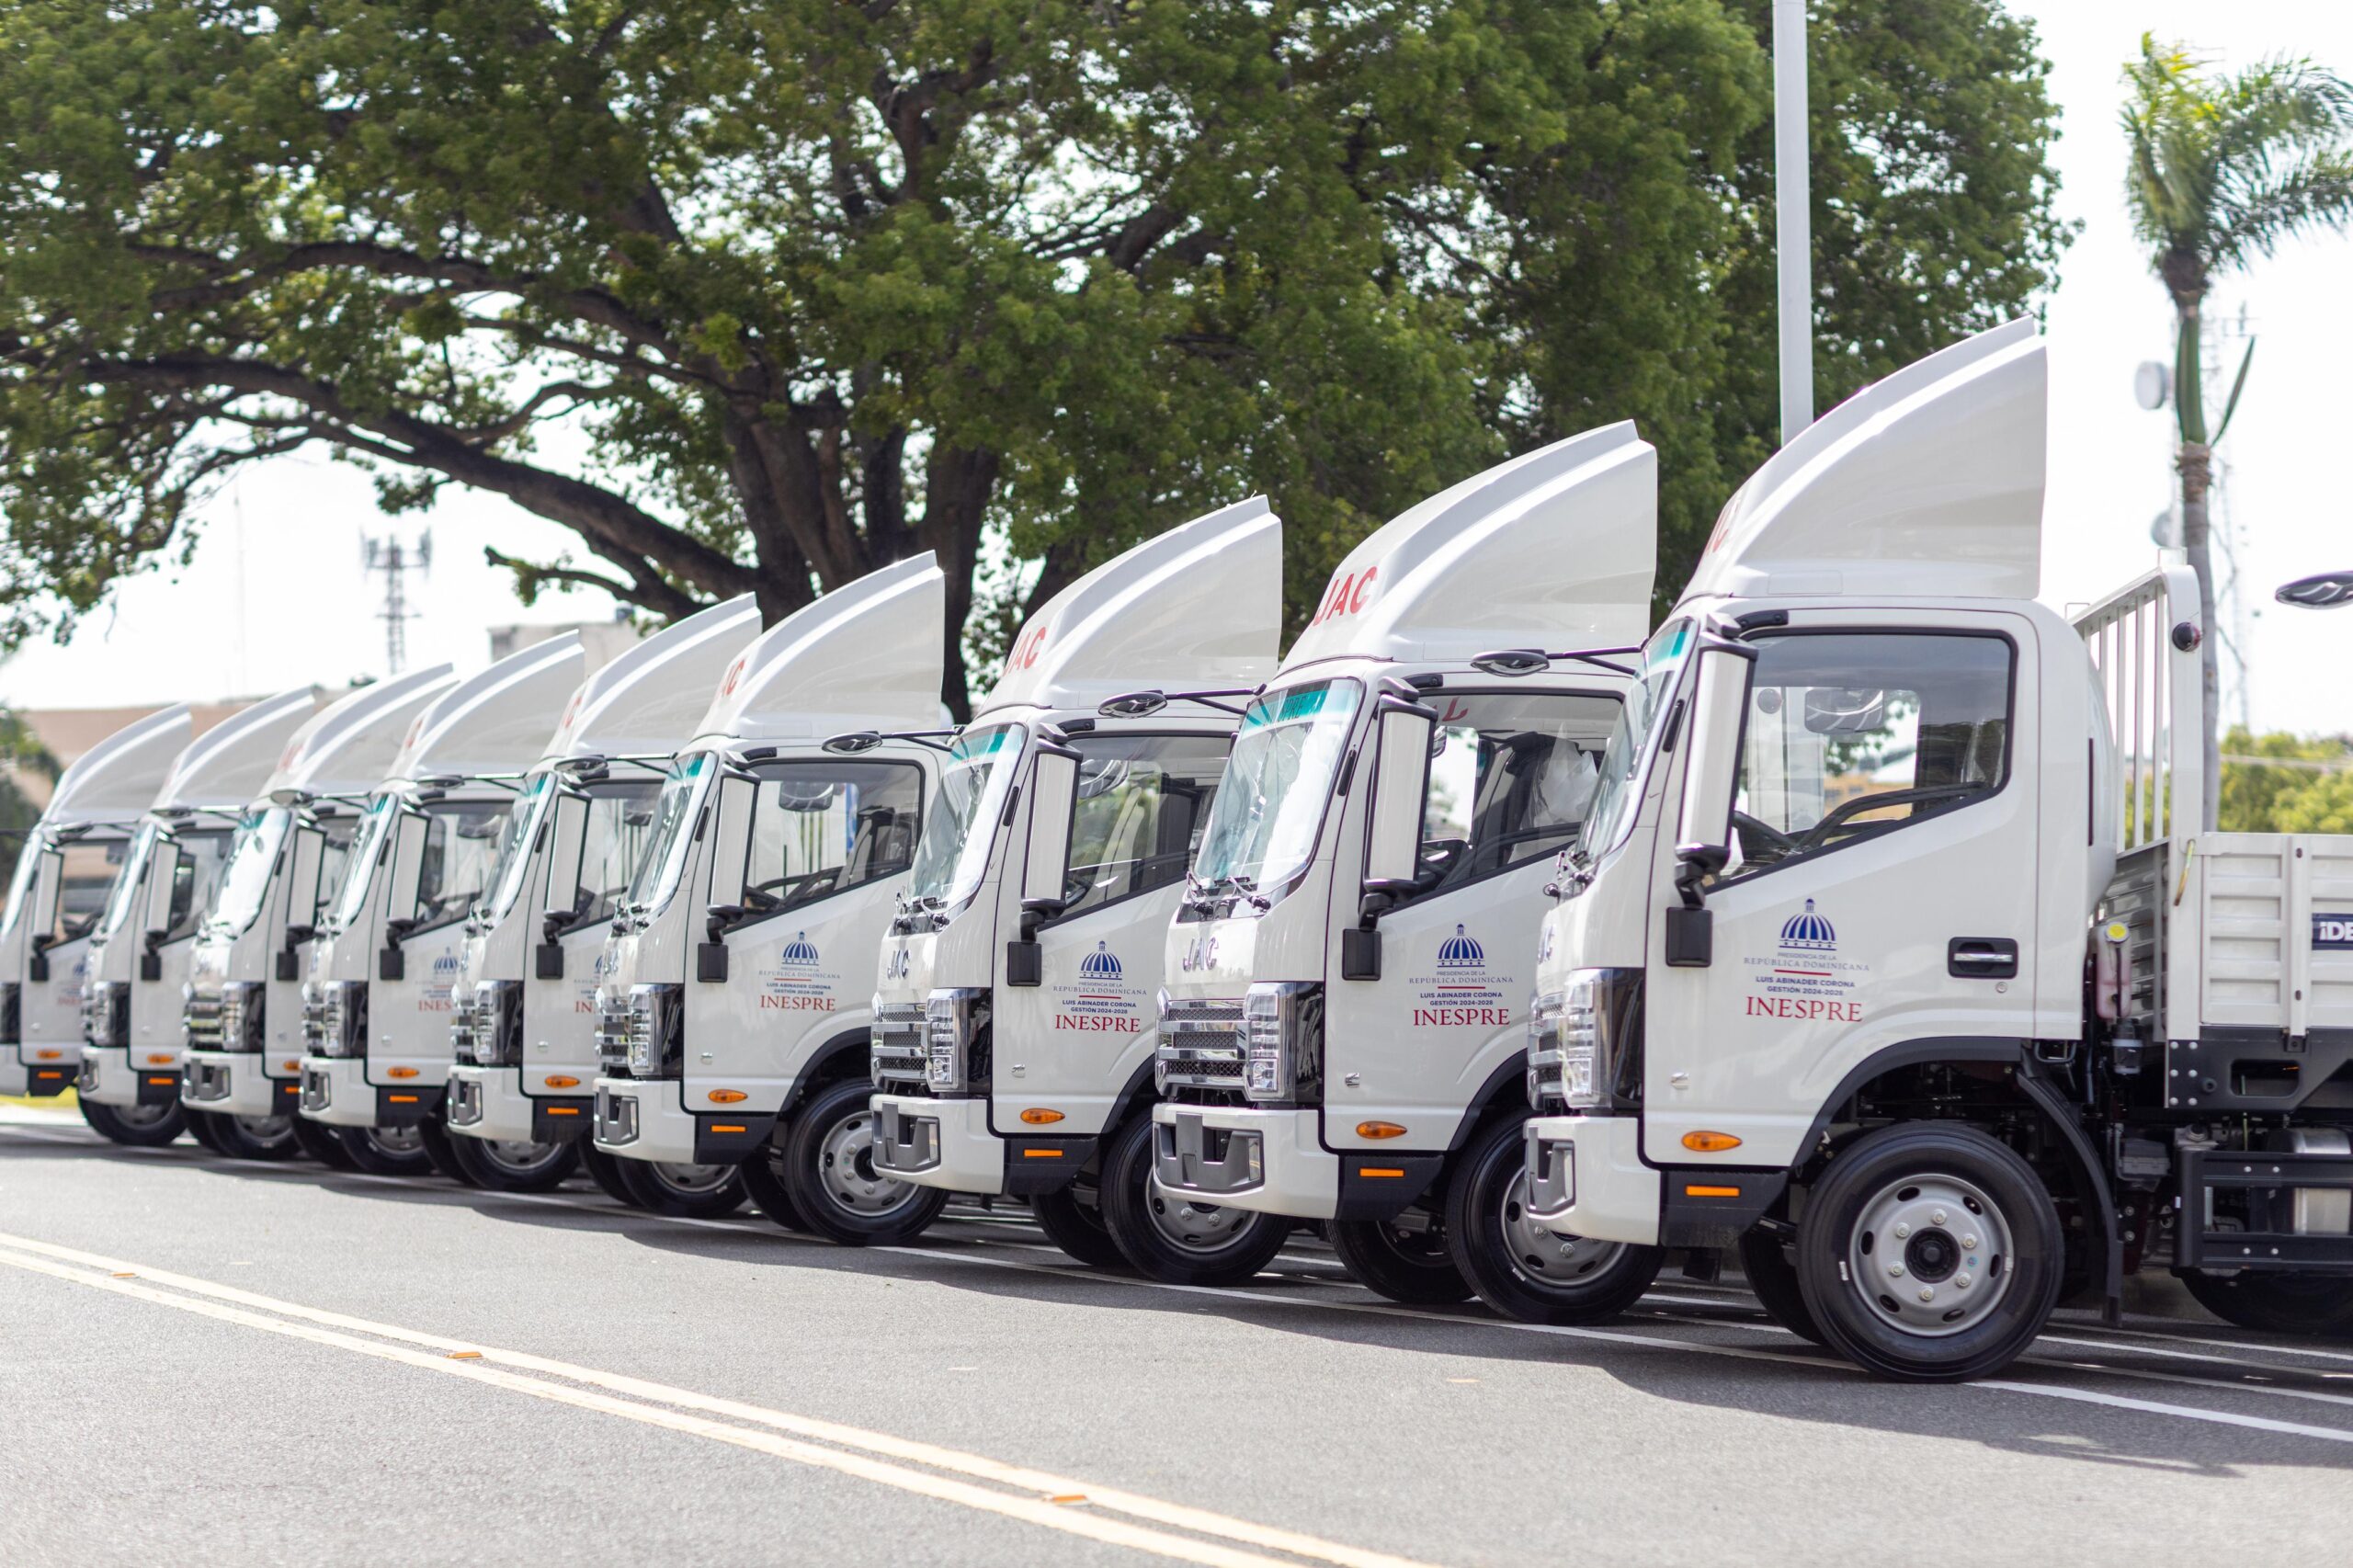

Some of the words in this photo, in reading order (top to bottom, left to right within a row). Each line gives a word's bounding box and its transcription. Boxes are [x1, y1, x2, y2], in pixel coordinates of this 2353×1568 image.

[1313, 565, 1378, 627] JAC
[1182, 937, 1220, 973] JAC
[1803, 960, 1870, 971] DOMINICANA
[1097, 987, 1147, 995] DOMINICANA
[1776, 977, 1818, 985] ABINADER
[1820, 980, 1856, 988] CORONA
[418, 1000, 452, 1012] INES
[760, 994, 836, 1012] INESPRE
[1745, 995, 1864, 1022] INESPRE
[1055, 1014, 1141, 1032] INESPRE
[1413, 1008, 1511, 1027] INESPRE
